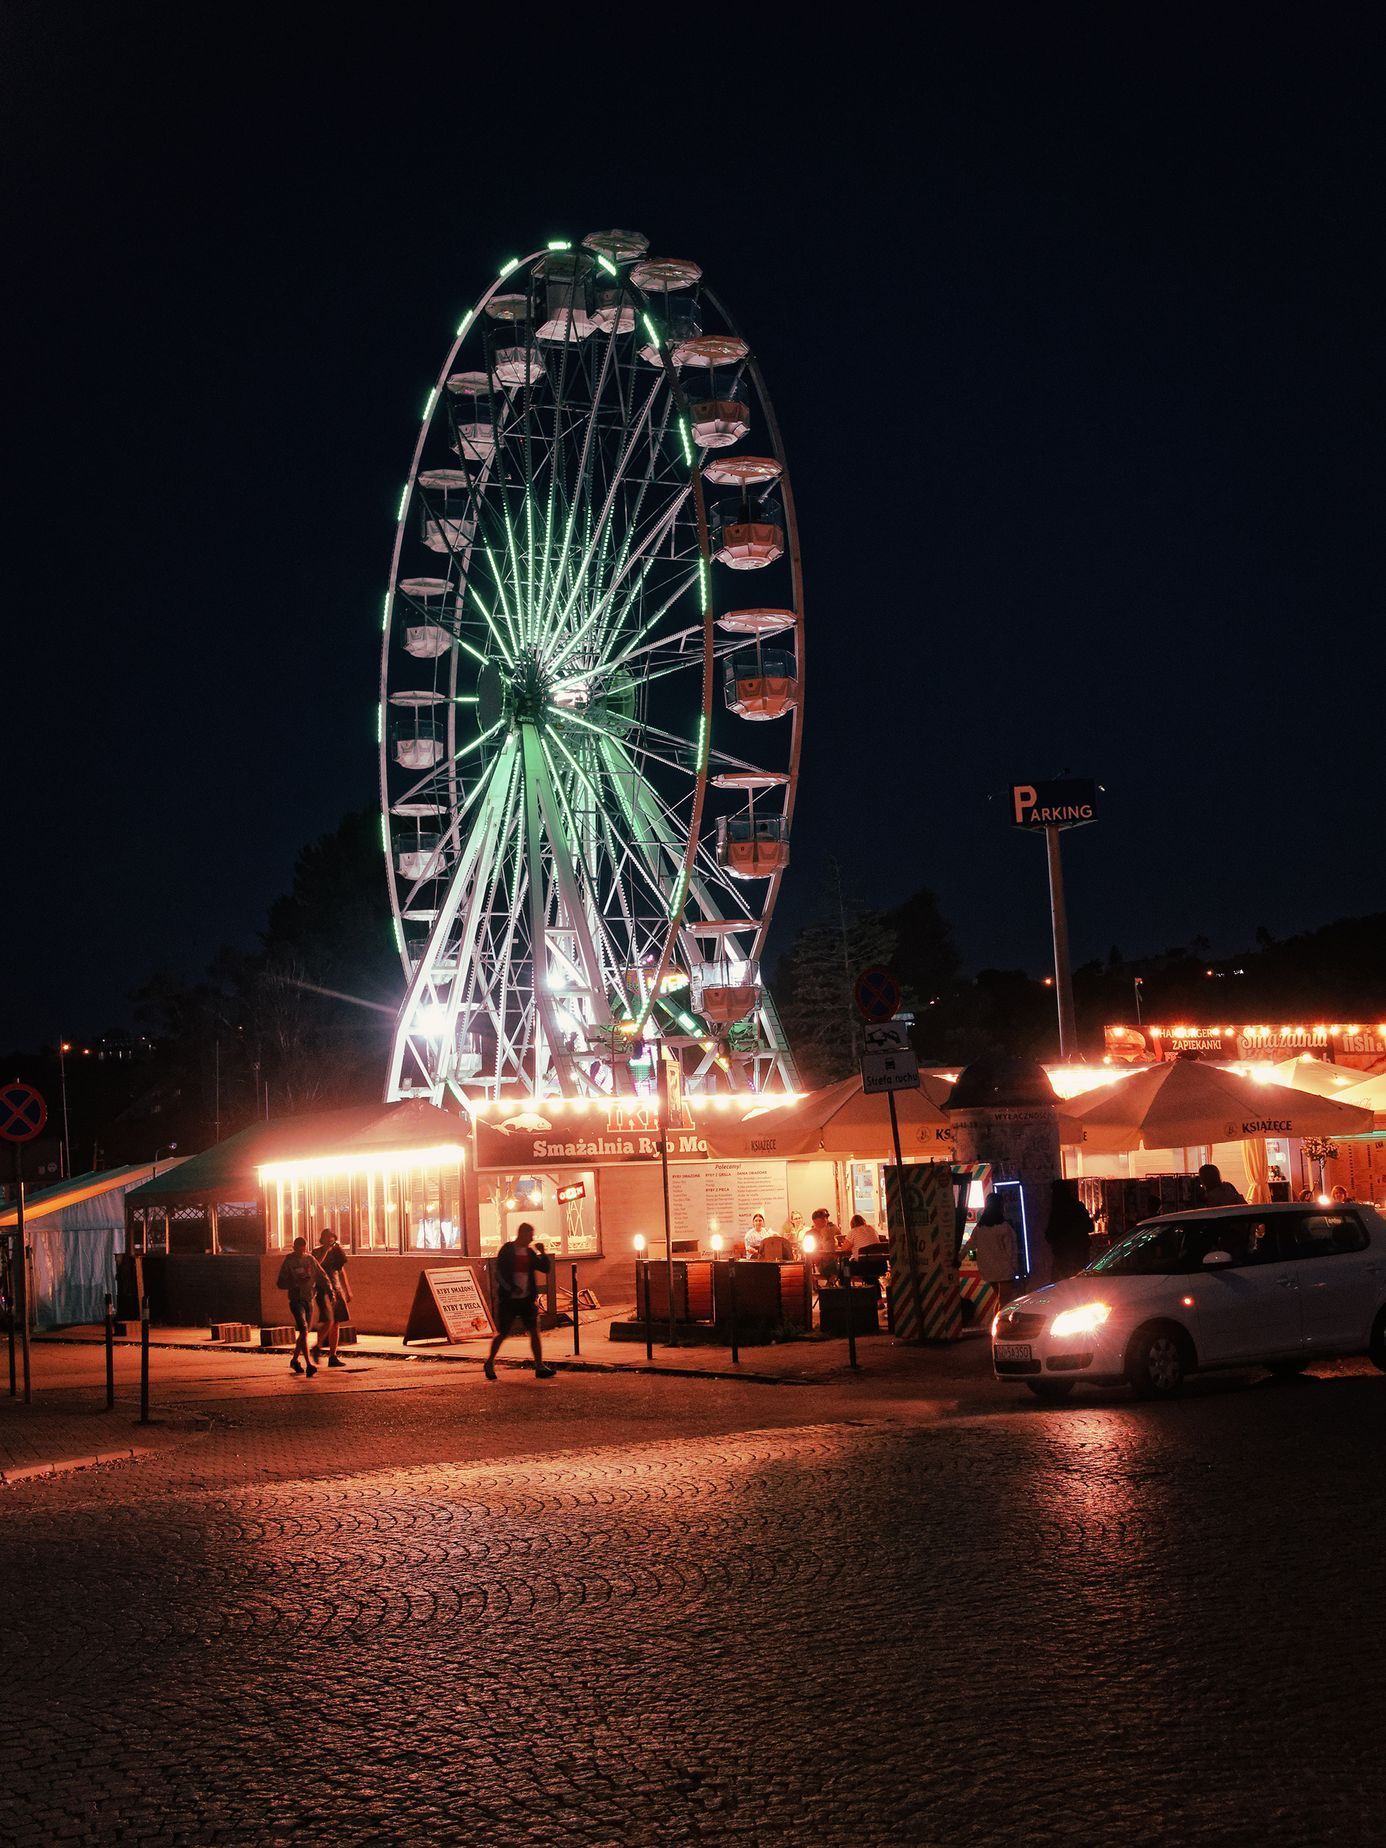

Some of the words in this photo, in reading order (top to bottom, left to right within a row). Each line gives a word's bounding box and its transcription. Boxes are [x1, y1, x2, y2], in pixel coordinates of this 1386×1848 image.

[1013, 785, 1093, 824] PARKING
[1159, 1028, 1213, 1038] HAURGER
[1172, 1039, 1222, 1050] ZAPIEKANKI
[1343, 1033, 1375, 1052] fish
[866, 1074, 892, 1087] Strefa
[1242, 1118, 1293, 1134] KSIĄŻĘCE
[533, 1137, 635, 1158] Smażalnia
[679, 1136, 708, 1153] Mo
[442, 1304, 459, 1312] RYBY
[464, 1302, 481, 1310] PIECA
